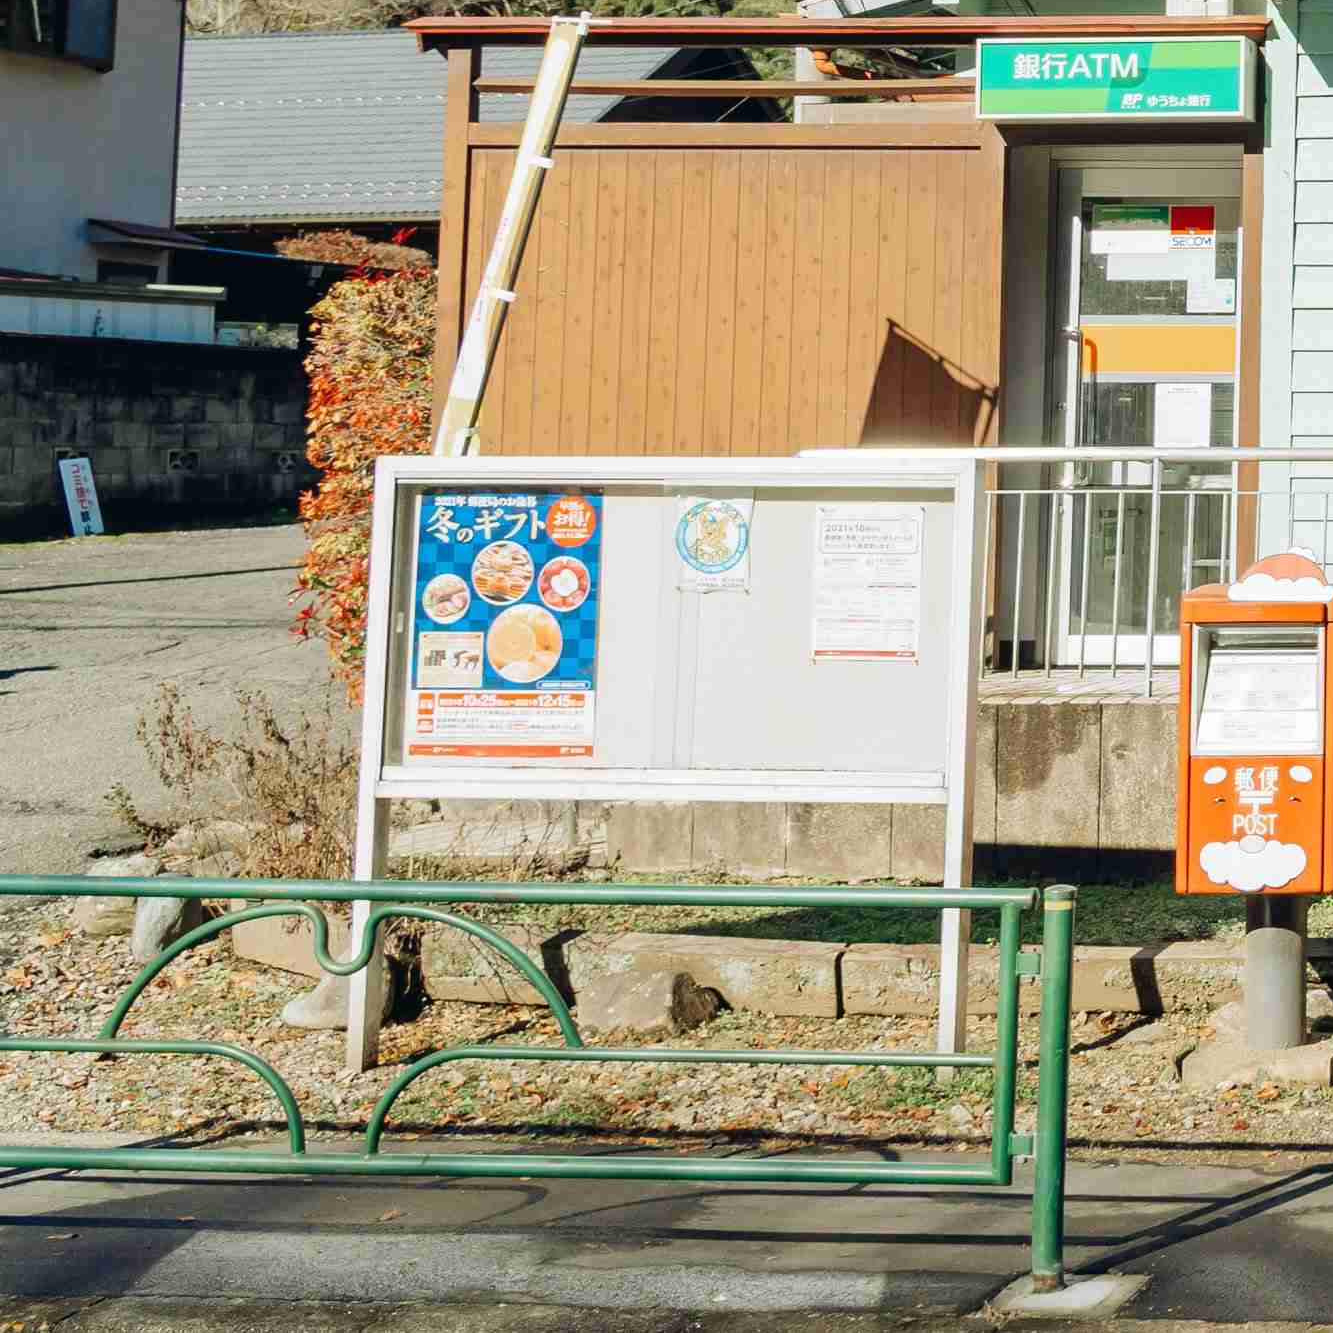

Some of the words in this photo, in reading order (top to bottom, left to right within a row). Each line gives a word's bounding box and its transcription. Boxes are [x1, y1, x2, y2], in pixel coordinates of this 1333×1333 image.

[1012, 52, 1140, 80] 銀行ATM
[1146, 94, 1212, 107] ゆうちょ銀行
[1171, 236, 1212, 247] SECOM
[427, 506, 546, 543] 冬のギフト
[1234, 766, 1280, 792] 郵便
[1232, 813, 1280, 835] POST
